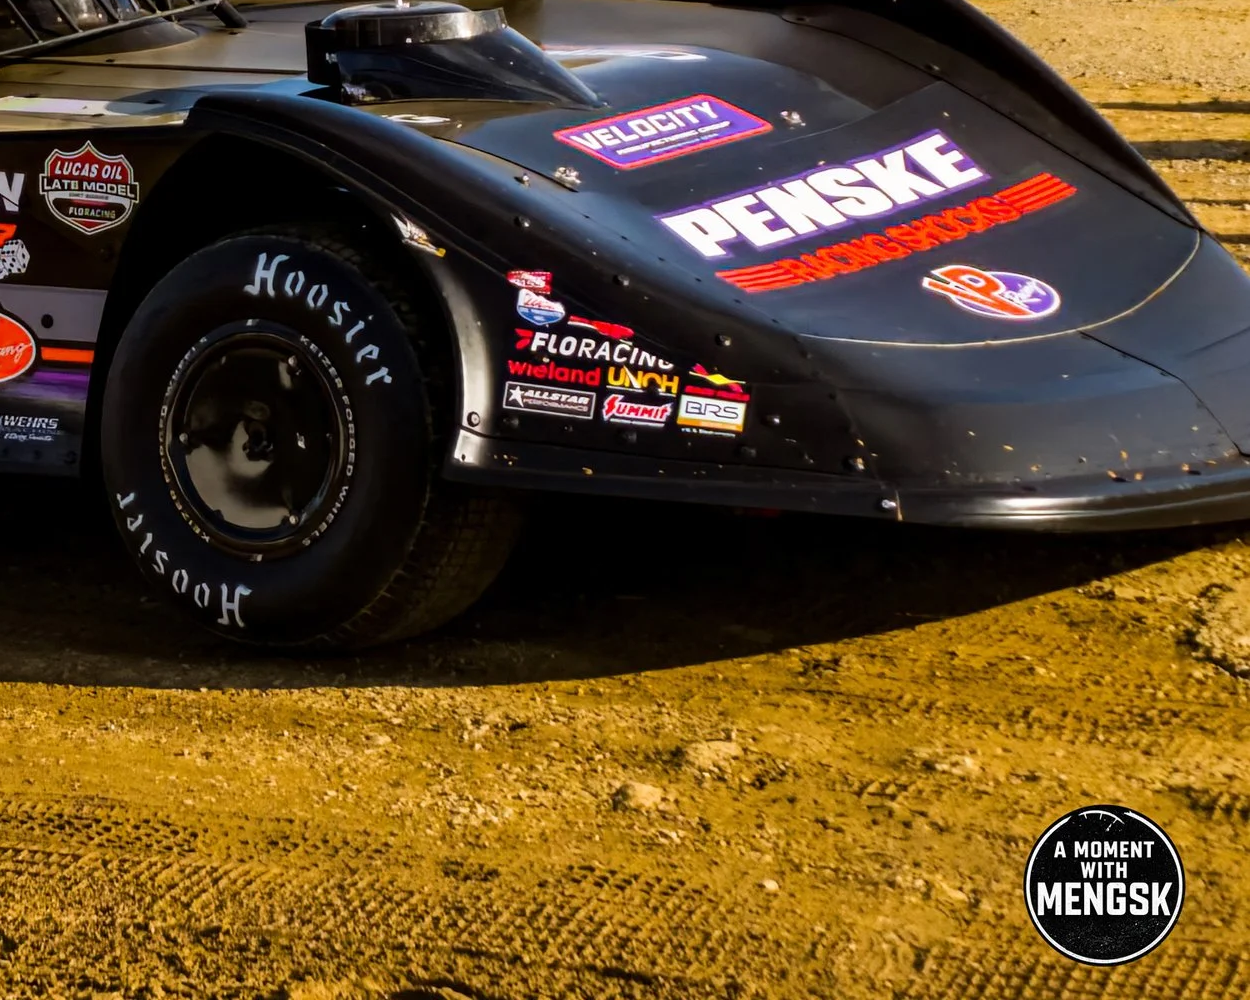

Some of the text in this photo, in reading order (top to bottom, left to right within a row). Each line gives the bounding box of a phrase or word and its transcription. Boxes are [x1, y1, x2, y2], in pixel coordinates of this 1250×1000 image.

[570, 101, 719, 151] VELOCITY
[54, 161, 123, 180] LUCAS OIL
[43, 179, 79, 190] LATE
[82, 181, 135, 198] MODEL
[659, 131, 984, 259] PENSKE
[68, 206, 116, 219] FLORACING
[780, 195, 1024, 283] RACING SHOCKS
[922, 264, 1035, 318] VP
[243, 251, 393, 387] Hoosier
[523, 388, 591, 405] ALLSTAR
[523, 398, 590, 412] PERFORMANCE
[684, 400, 739, 419] BRS
[3, 414, 60, 430] WEHRS
[300, 334, 357, 548] KEIZER FORGED WHEELS
[116, 491, 254, 629] Hoosier
